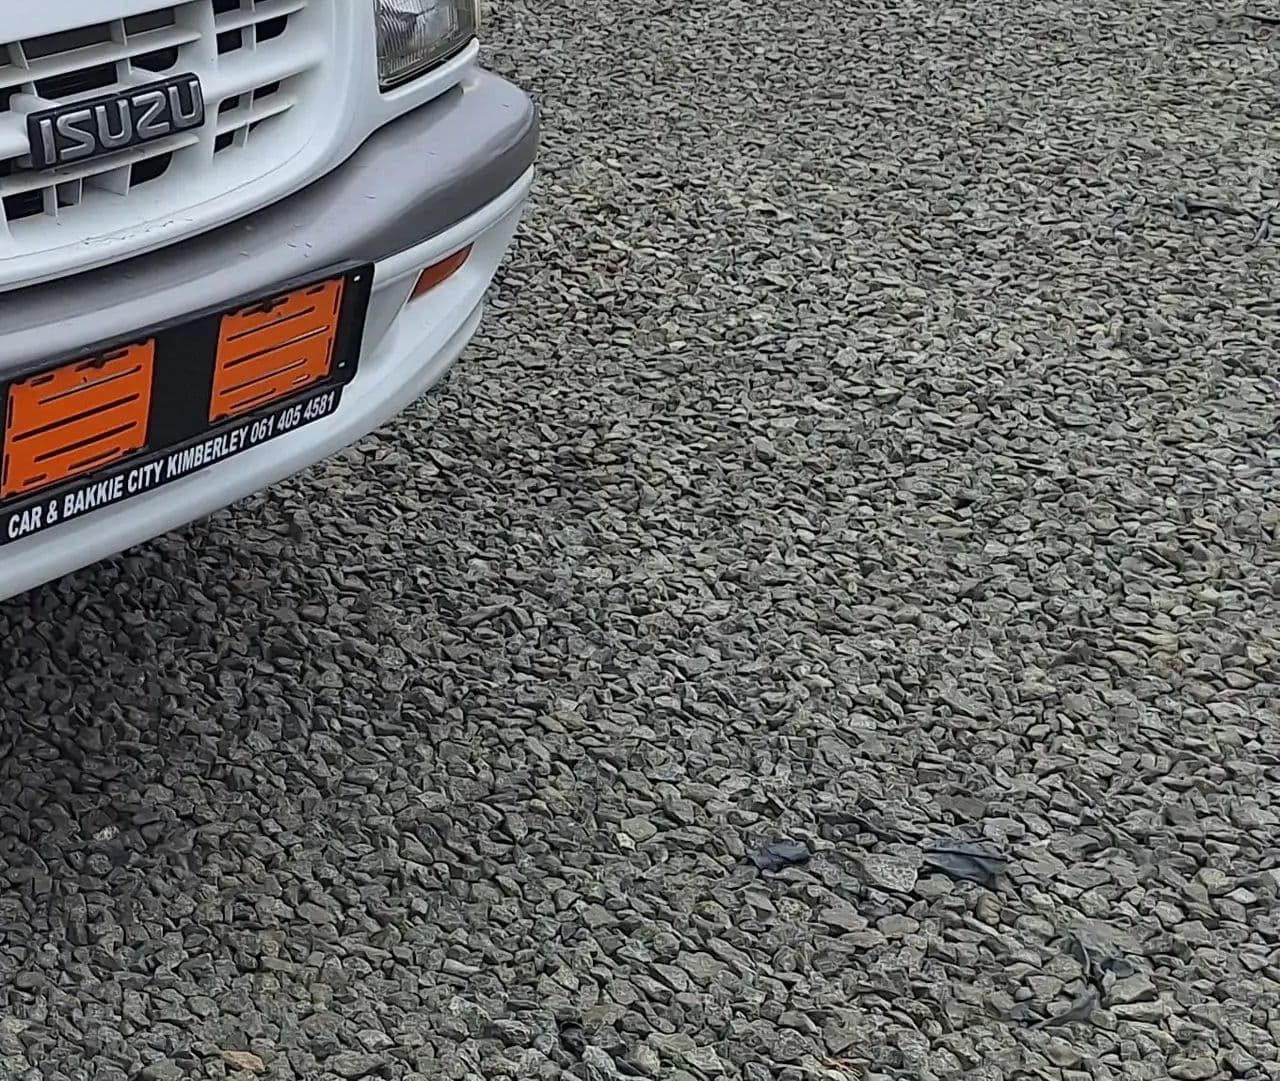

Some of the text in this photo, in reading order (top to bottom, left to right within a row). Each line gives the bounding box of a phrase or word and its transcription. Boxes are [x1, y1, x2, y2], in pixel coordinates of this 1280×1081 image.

[40, 80, 203, 164] ISUZU
[8, 392, 335, 539] CAR & BAKKIE CITY KIMBERLEY 061 405 4581
